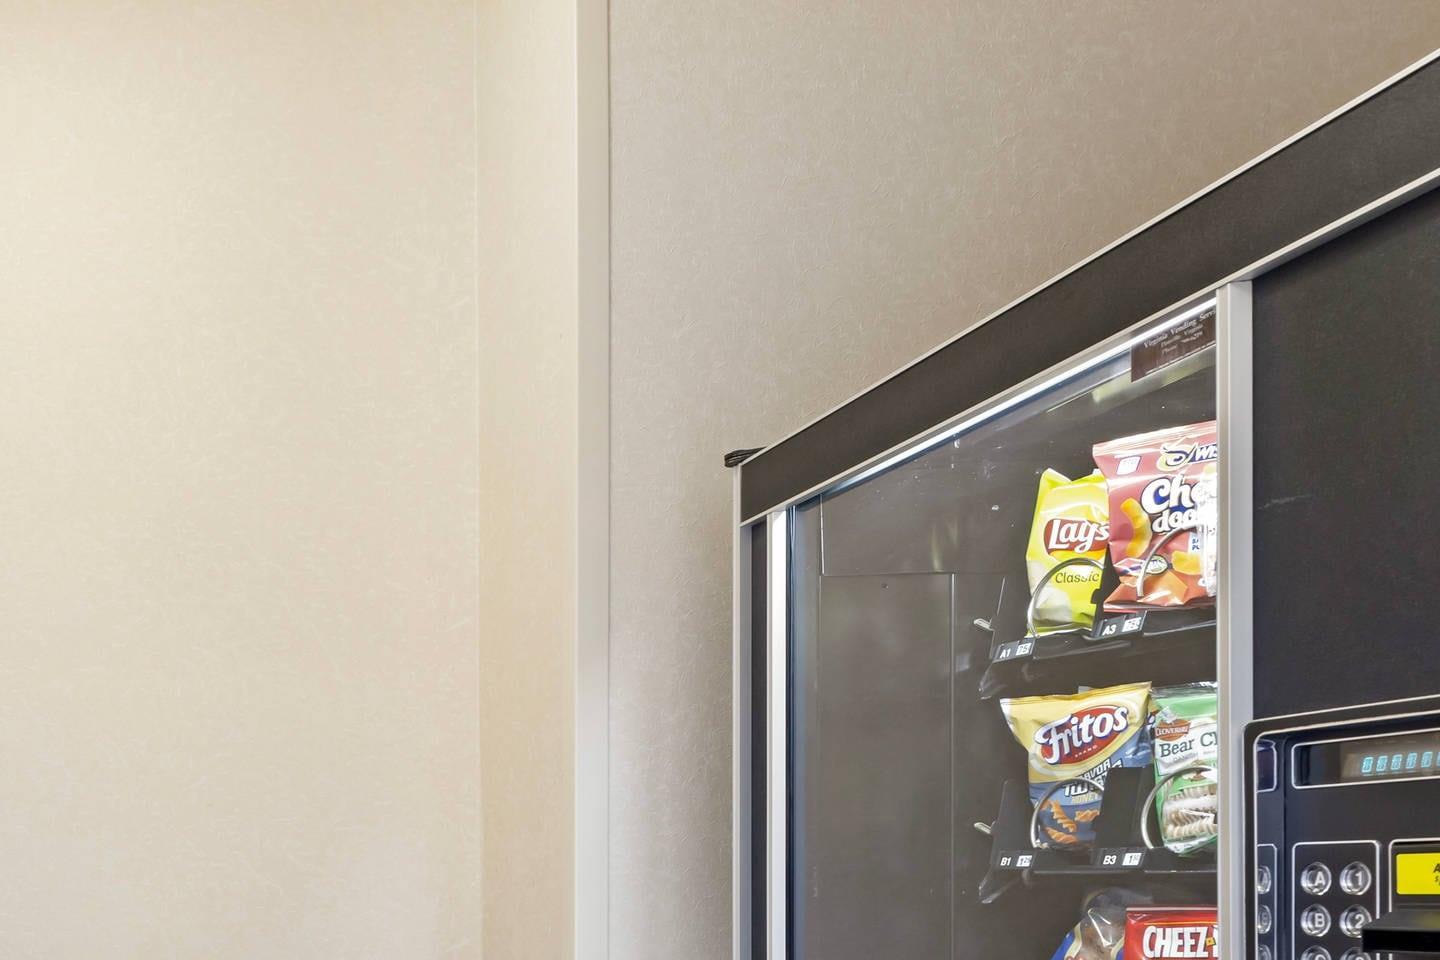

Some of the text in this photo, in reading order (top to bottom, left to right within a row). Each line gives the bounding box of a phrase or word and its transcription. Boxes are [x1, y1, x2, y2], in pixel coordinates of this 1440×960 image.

[1055, 571, 1100, 584] Classic
[1000, 648, 1011, 659] A1
[1034, 706, 1129, 764] Fritos
[1159, 739, 1195, 757] Bear
[1000, 856, 1011, 866] B1
[1103, 855, 1117, 865] B3
[1314, 871, 1326, 887] A
[1354, 871, 1362, 886] 1
[1315, 913, 1325, 928] B
[1354, 913, 1365, 929] 2
